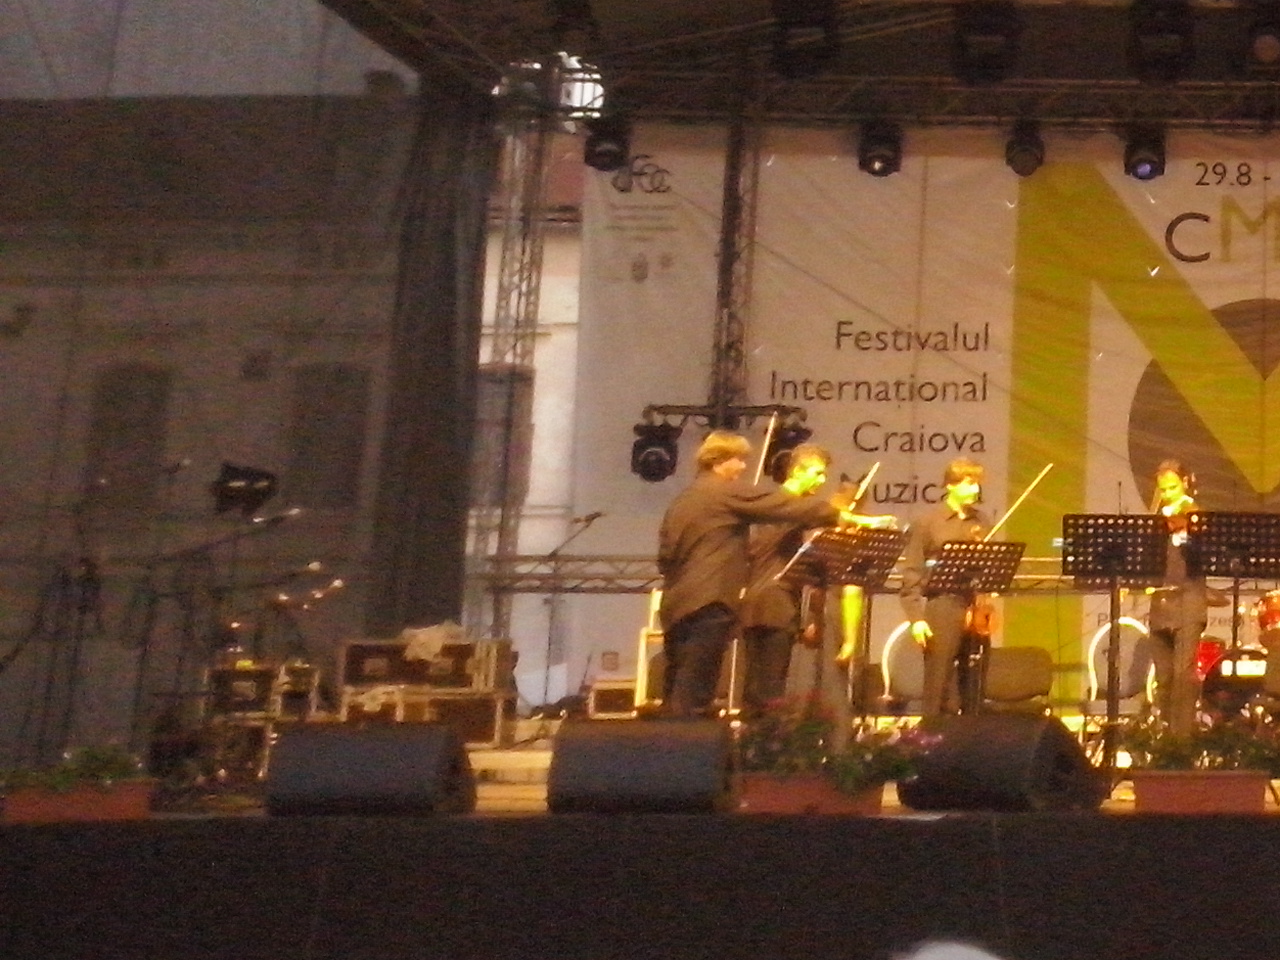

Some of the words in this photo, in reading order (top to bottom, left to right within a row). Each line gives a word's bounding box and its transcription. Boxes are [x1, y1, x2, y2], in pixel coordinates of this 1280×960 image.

[1195, 162, 1252, 187] 29.8
[835, 320, 990, 352] Festivalul
[852, 420, 986, 453] Craiova
